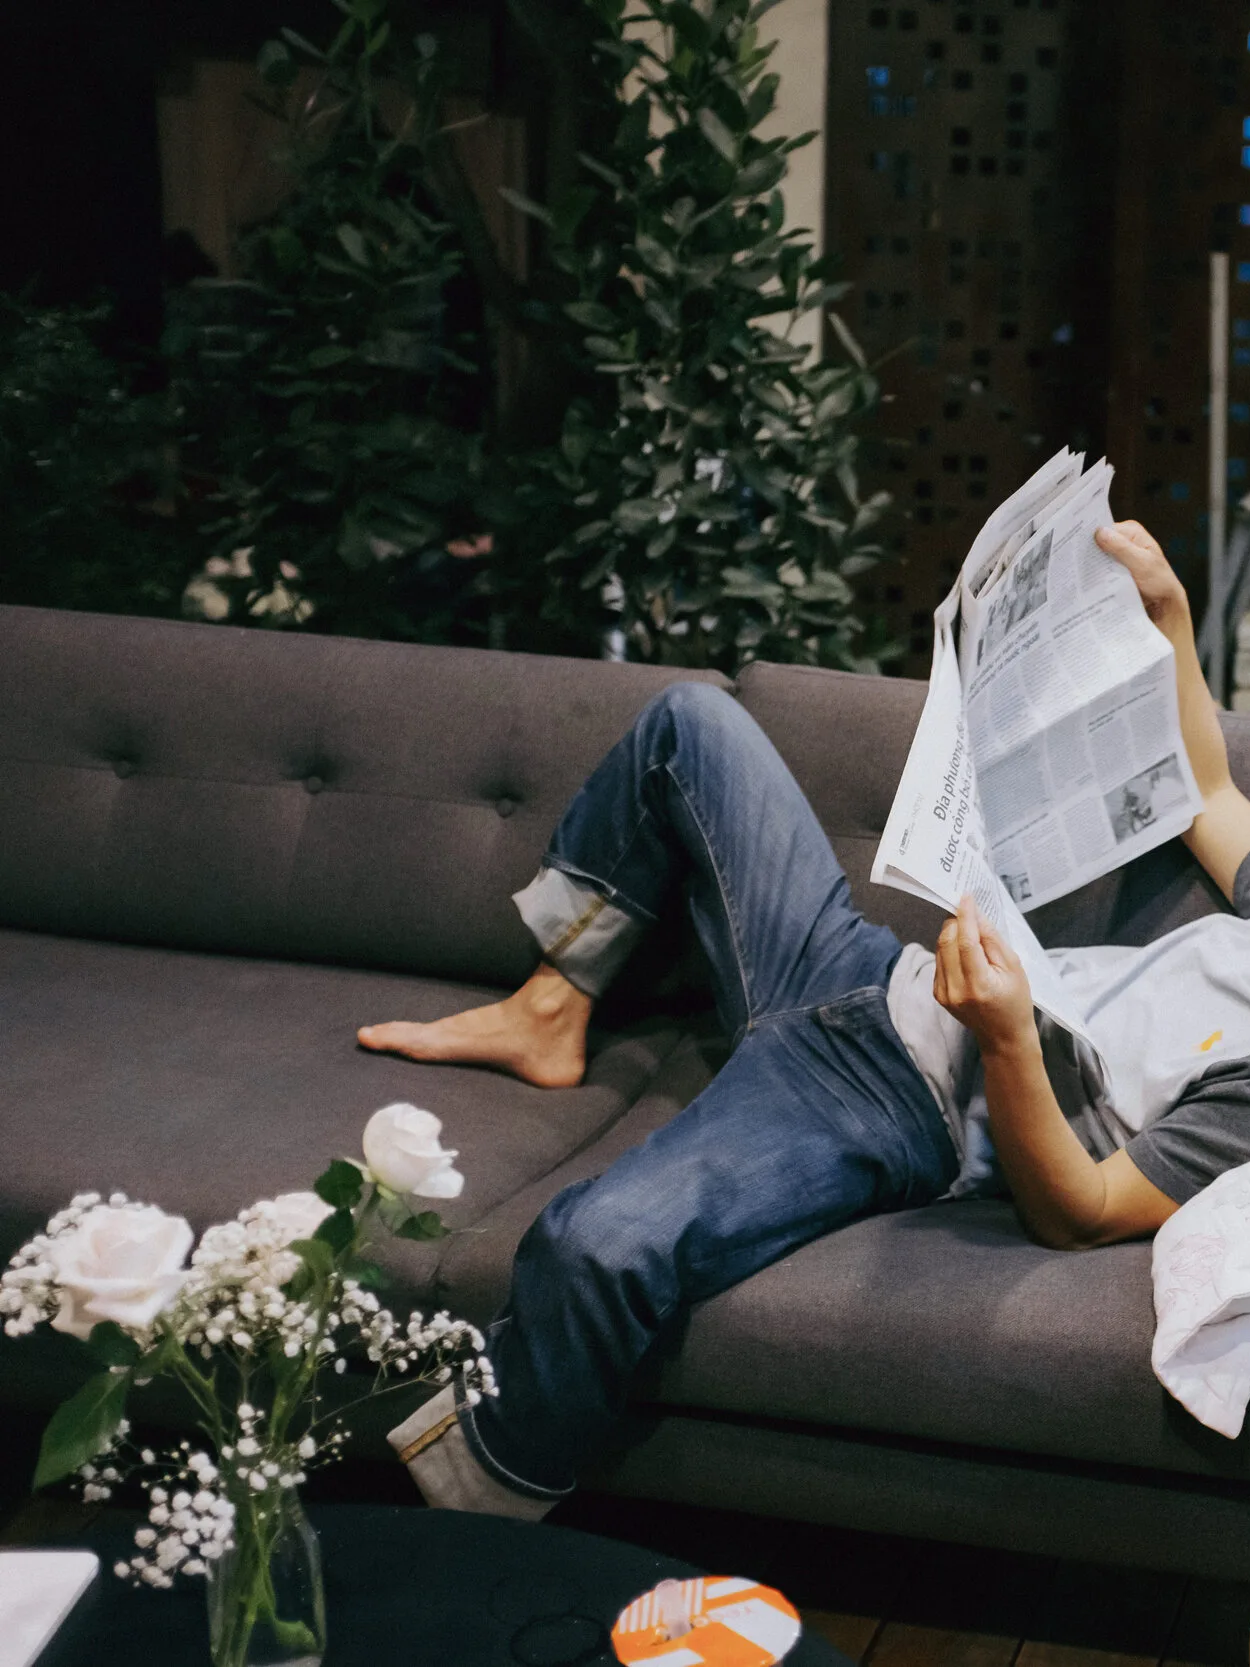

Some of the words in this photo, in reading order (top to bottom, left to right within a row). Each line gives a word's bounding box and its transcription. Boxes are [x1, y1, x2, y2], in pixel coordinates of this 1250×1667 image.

[933, 795, 952, 821] Địa
[940, 834, 960, 873] được
[952, 799, 970, 835] công
